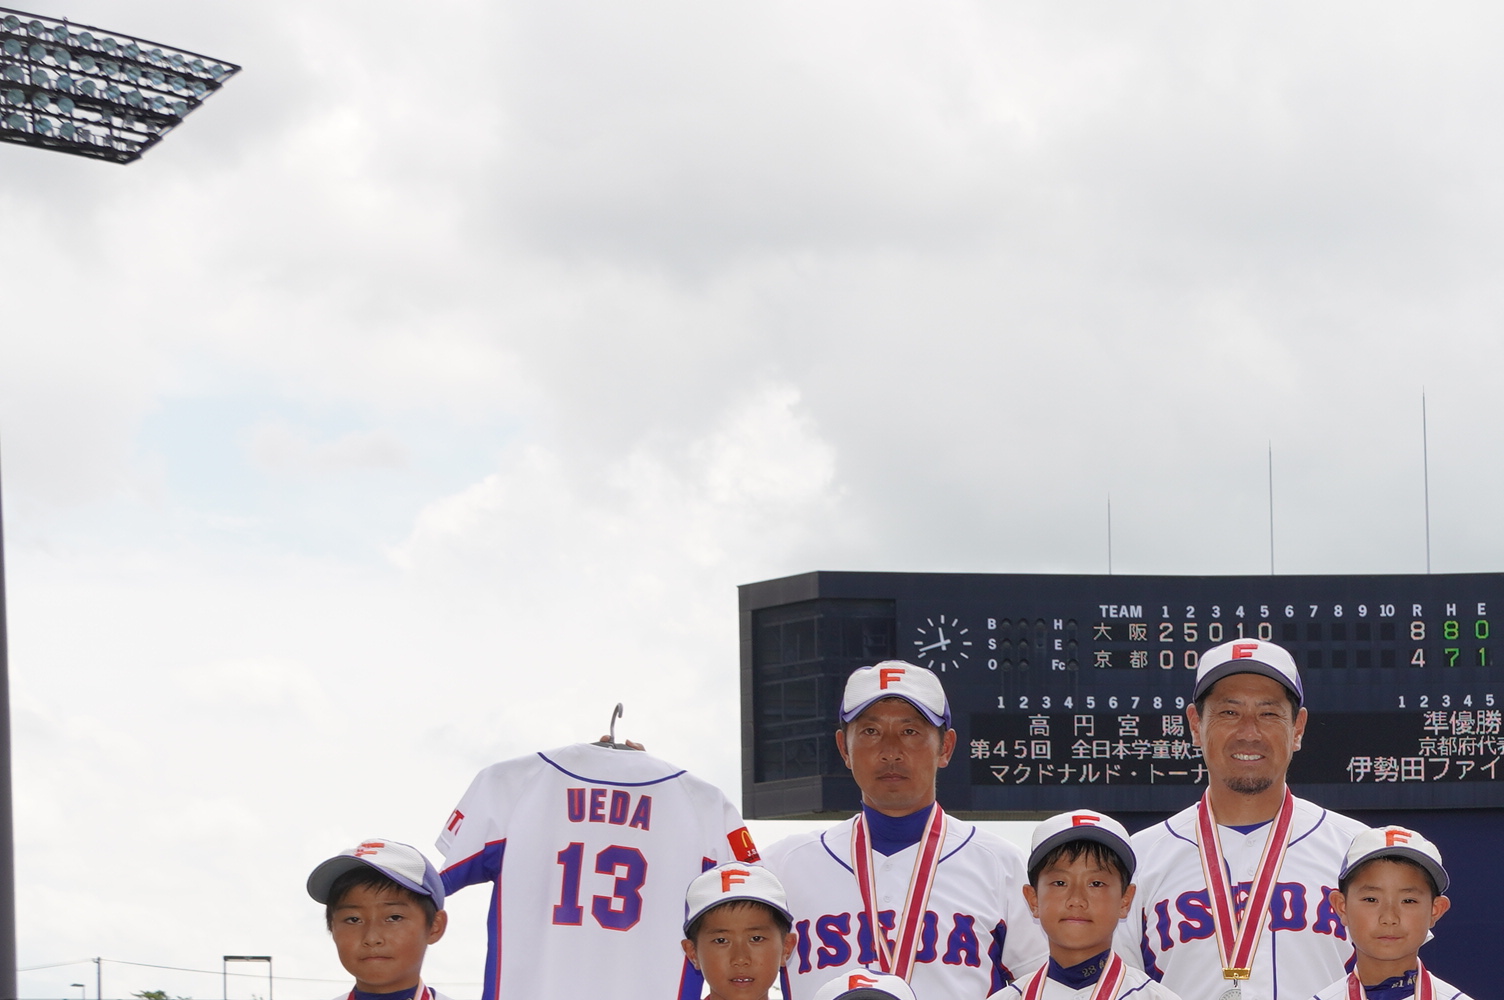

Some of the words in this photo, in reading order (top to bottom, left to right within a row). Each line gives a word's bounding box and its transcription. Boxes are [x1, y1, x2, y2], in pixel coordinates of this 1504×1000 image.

[1099, 604, 1143, 618] TEAM
[1162, 605, 1170, 618] 1
[1186, 605, 1195, 618] 2
[1212, 605, 1221, 618] 3
[1235, 605, 1245, 618] 4
[1260, 605, 1269, 618] 5
[1285, 605, 1294, 618] 6
[1310, 605, 1318, 617] 7
[1334, 605, 1343, 617] 8
[1358, 605, 1367, 617] 9
[1379, 604, 1396, 617] 10
[1412, 603, 1422, 617] R
[1446, 603, 1457, 616] H
[1477, 602, 1487, 616] E
[987, 618, 997, 630] B
[1053, 618, 1063, 630] H
[1093, 622, 1148, 641] 大阪
[1159, 622, 1174, 642] 2
[1184, 622, 1198, 642] 5
[1208, 622, 1223, 642] 0
[1236, 622, 1245, 639] 1
[1258, 622, 1272, 642] 0
[1410, 620, 1425, 641] 8
[1443, 620, 1459, 640] 8
[1475, 619, 1489, 640] 0
[988, 638, 997, 650] S
[1054, 639, 1063, 651] E
[1231, 643, 1259, 660] F
[1051, 659, 1066, 671] Fc
[1093, 650, 1148, 669] 京都
[1159, 650, 1174, 670] 0
[1184, 650, 1198, 670] 0
[1410, 648, 1426, 668] 4
[1444, 648, 1460, 667] 7
[1478, 647, 1486, 667] 1
[879, 668, 906, 690] F
[997, 696, 1005, 709] 1
[1019, 696, 1029, 709] 2
[1042, 696, 1051, 709] 3
[1063, 696, 1073, 709] 4
[1086, 696, 1096, 709] 5
[1108, 696, 1118, 709] 6
[1131, 696, 1140, 709] 7
[1153, 696, 1163, 709] 8
[1175, 696, 1185, 709] 9
[1398, 695, 1406, 708] 1
[1419, 695, 1429, 708] 2
[1441, 695, 1451, 708] 3
[1463, 694, 1473, 707] 4
[1485, 694, 1495, 706] 5
[1423, 709, 1502, 736] 準優勝
[970, 739, 1051, 760] 第45回
[567, 787, 652, 831] UEDA
[1384, 829, 1412, 847] F
[354, 840, 386, 858] F
[552, 842, 648, 931] 13
[720, 869, 751, 893] F
[796, 909, 980, 974] ISEDA
